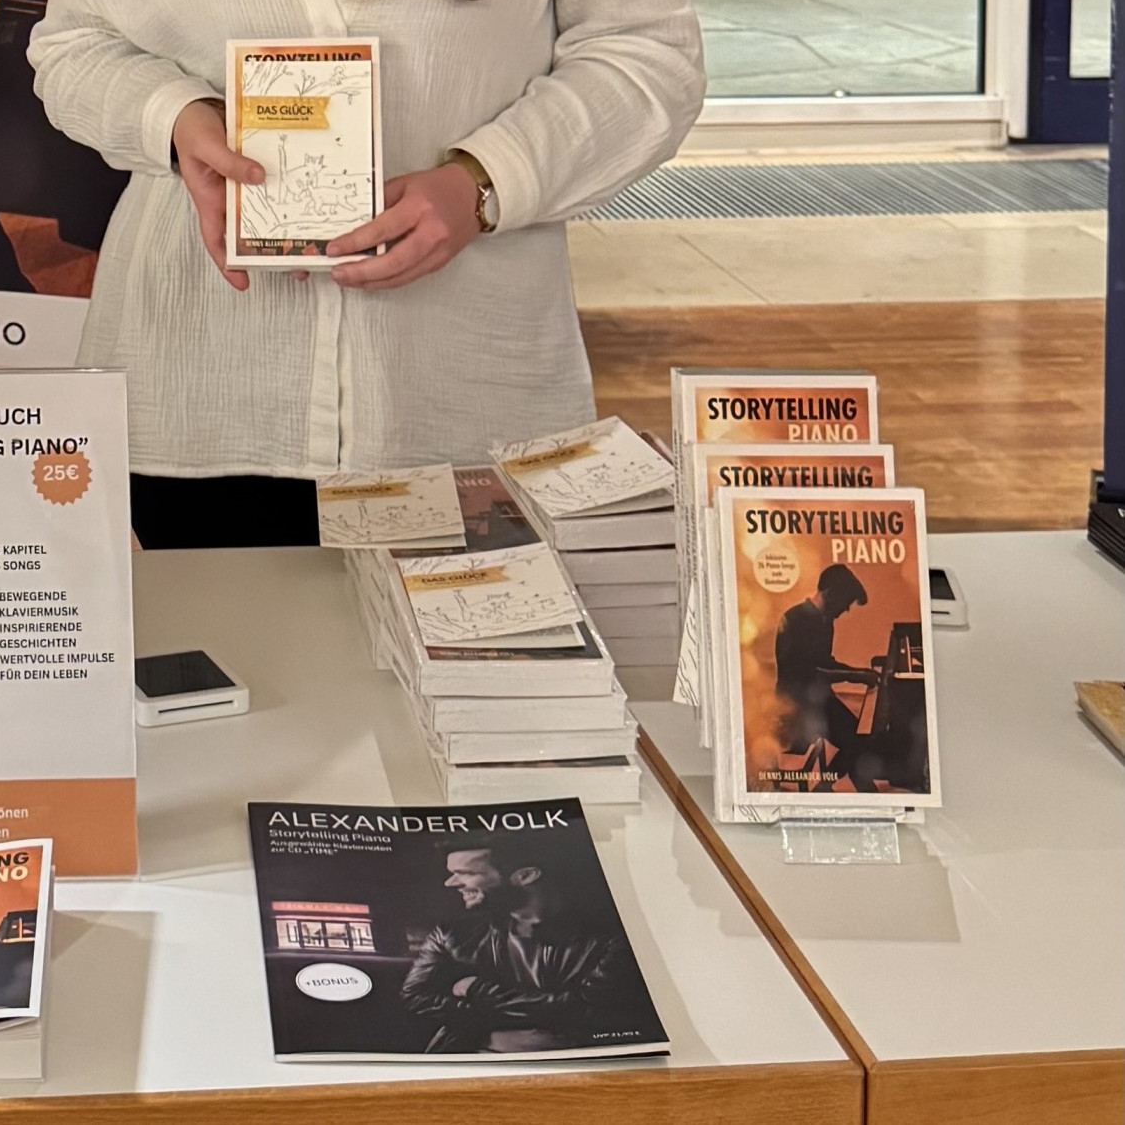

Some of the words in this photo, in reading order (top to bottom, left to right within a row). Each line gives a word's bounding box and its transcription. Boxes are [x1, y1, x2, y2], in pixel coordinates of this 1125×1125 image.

[257, 105, 277, 115] DAS
[707, 397, 857, 421] STORYTELLING
[788, 424, 858, 442] PIANO
[43, 464, 79, 481] 25€
[719, 465, 873, 488] STORYTELLING
[745, 510, 904, 535] STORYTELLING
[3, 545, 47, 555] KAPITEL
[831, 538, 905, 564] PIANO
[3, 561, 41, 571] SONGS
[0, 591, 67, 601] BEWEGENDE
[0, 606, 79, 617] KLAVIERMUSIK
[0, 622, 82, 633] INSPIRIERENDE
[0, 638, 76, 648] GESCHICHTEN
[0, 653, 65, 664] WERTVOLLE
[67, 652, 115, 663] IMPULSE
[0, 669, 21, 680] FÜR
[24, 670, 50, 680] DEIN
[53, 669, 88, 679] LEBEN
[269, 810, 470, 834] ALEXANDER
[478, 809, 568, 831] VOLK
[268, 829, 349, 842] Storytelling
[352, 833, 391, 843] Piano
